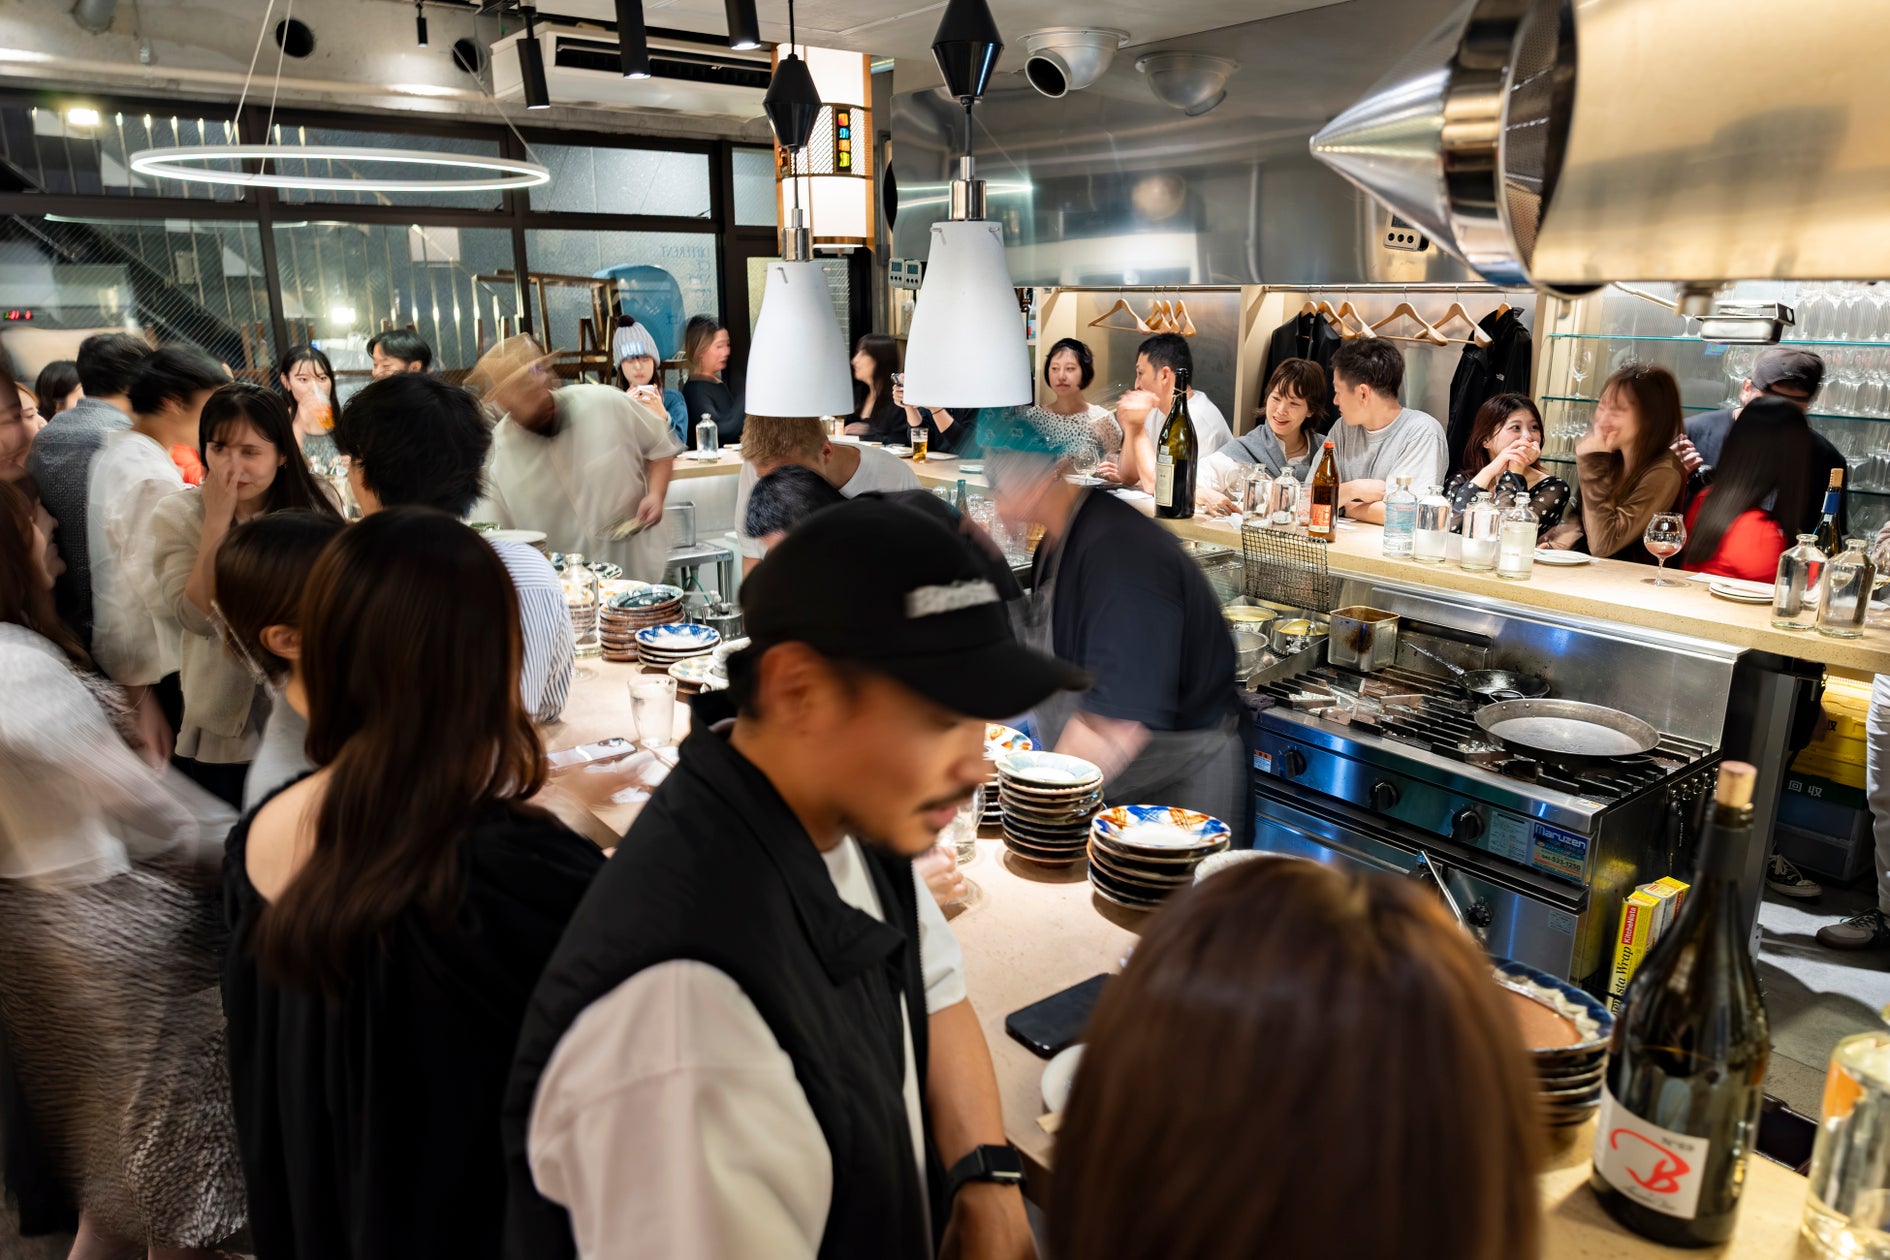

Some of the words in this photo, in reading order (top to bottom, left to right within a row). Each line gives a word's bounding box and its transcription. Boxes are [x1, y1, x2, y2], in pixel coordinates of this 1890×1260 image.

[1788, 780, 1823, 797] 回収
[1535, 824, 1586, 849] Maruzen
[1616, 946, 1634, 975] Wrap
